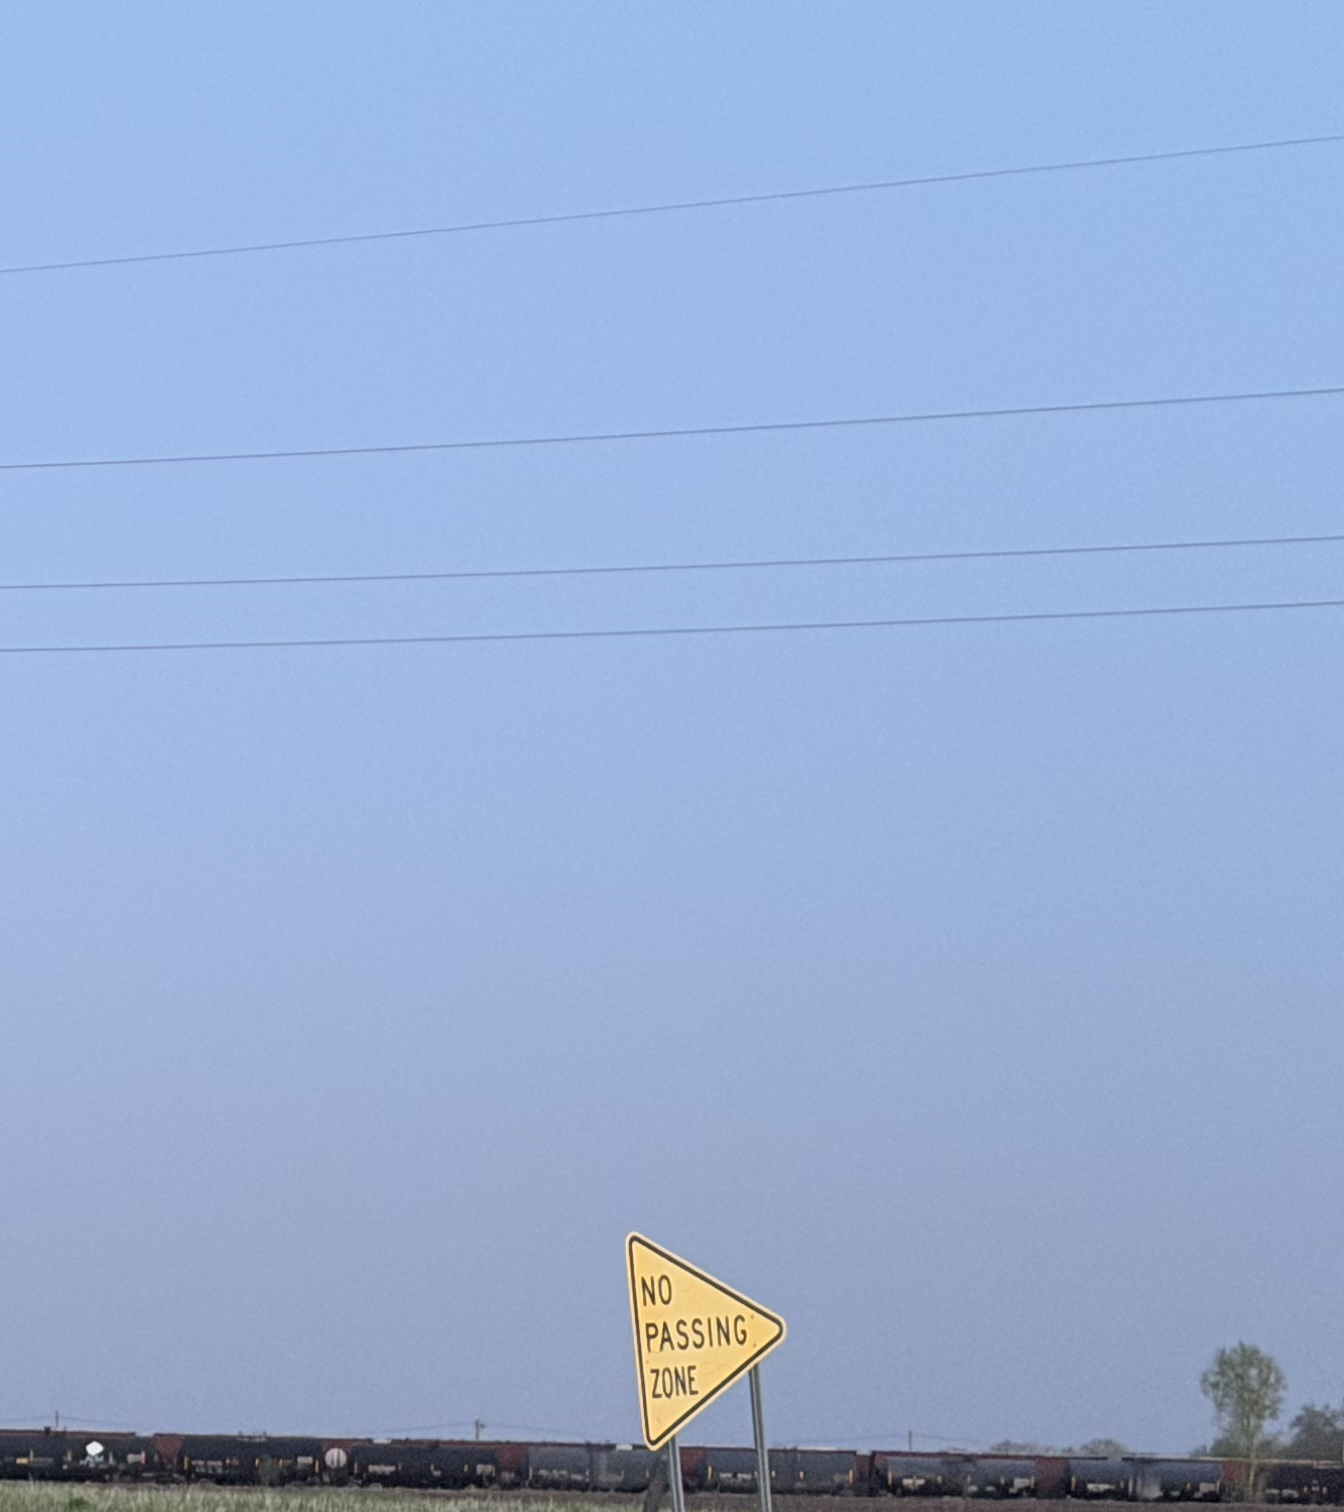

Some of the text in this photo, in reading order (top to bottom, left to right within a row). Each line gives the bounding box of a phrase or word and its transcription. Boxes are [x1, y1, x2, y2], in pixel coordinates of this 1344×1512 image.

[641, 1274, 672, 1306] NO
[645, 1314, 748, 1352] PASSING
[650, 1365, 699, 1399] ZONE
